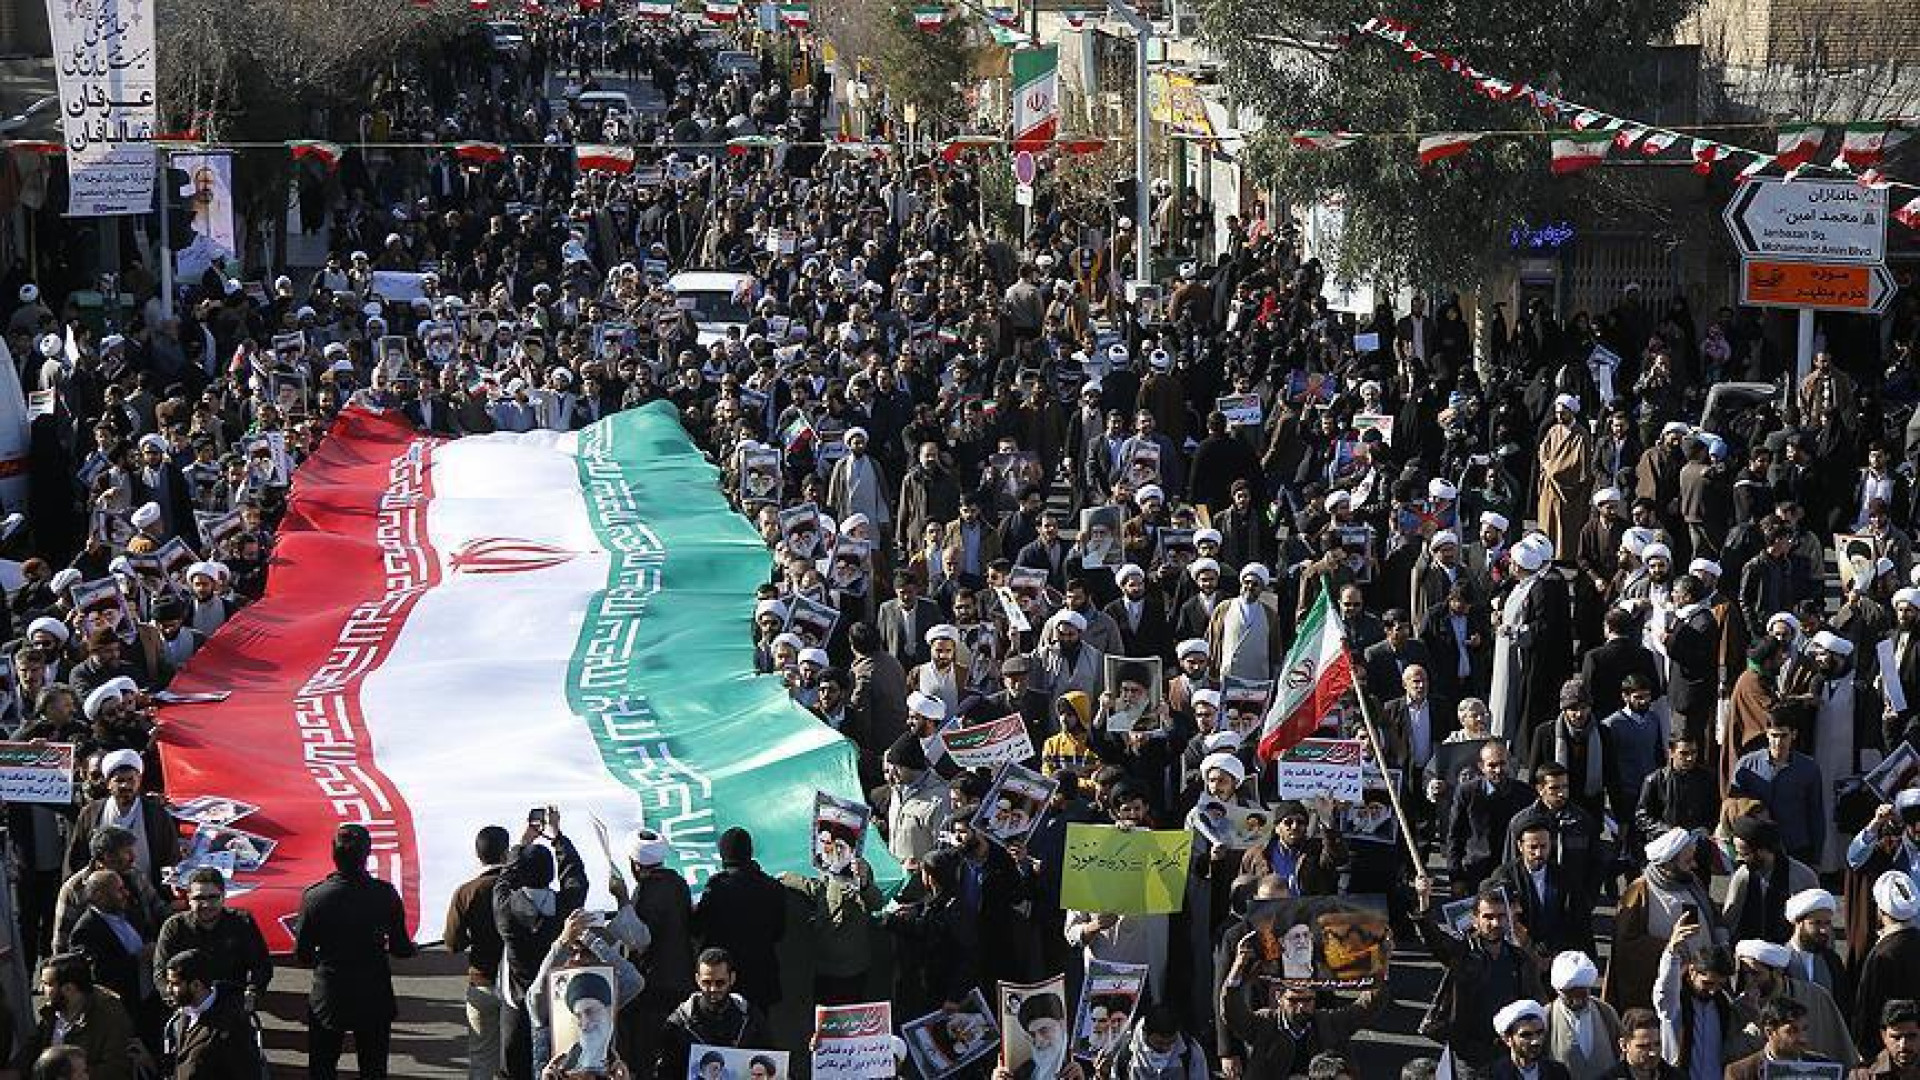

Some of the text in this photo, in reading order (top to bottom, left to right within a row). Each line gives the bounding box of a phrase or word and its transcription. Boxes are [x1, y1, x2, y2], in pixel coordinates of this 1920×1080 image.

[66, 83, 153, 117] عرفان
[1808, 188, 1859, 203] جانبازان
[1786, 208, 1818, 225] امین
[1819, 209, 1859, 224] محمد
[1763, 228, 1828, 242] Janbazan Sq.
[1761, 241, 1820, 254] Mohammad
[1820, 243, 1848, 255] Amin
[1809, 269, 1850, 283] موزه
[1837, 287, 1867, 301] حرم
